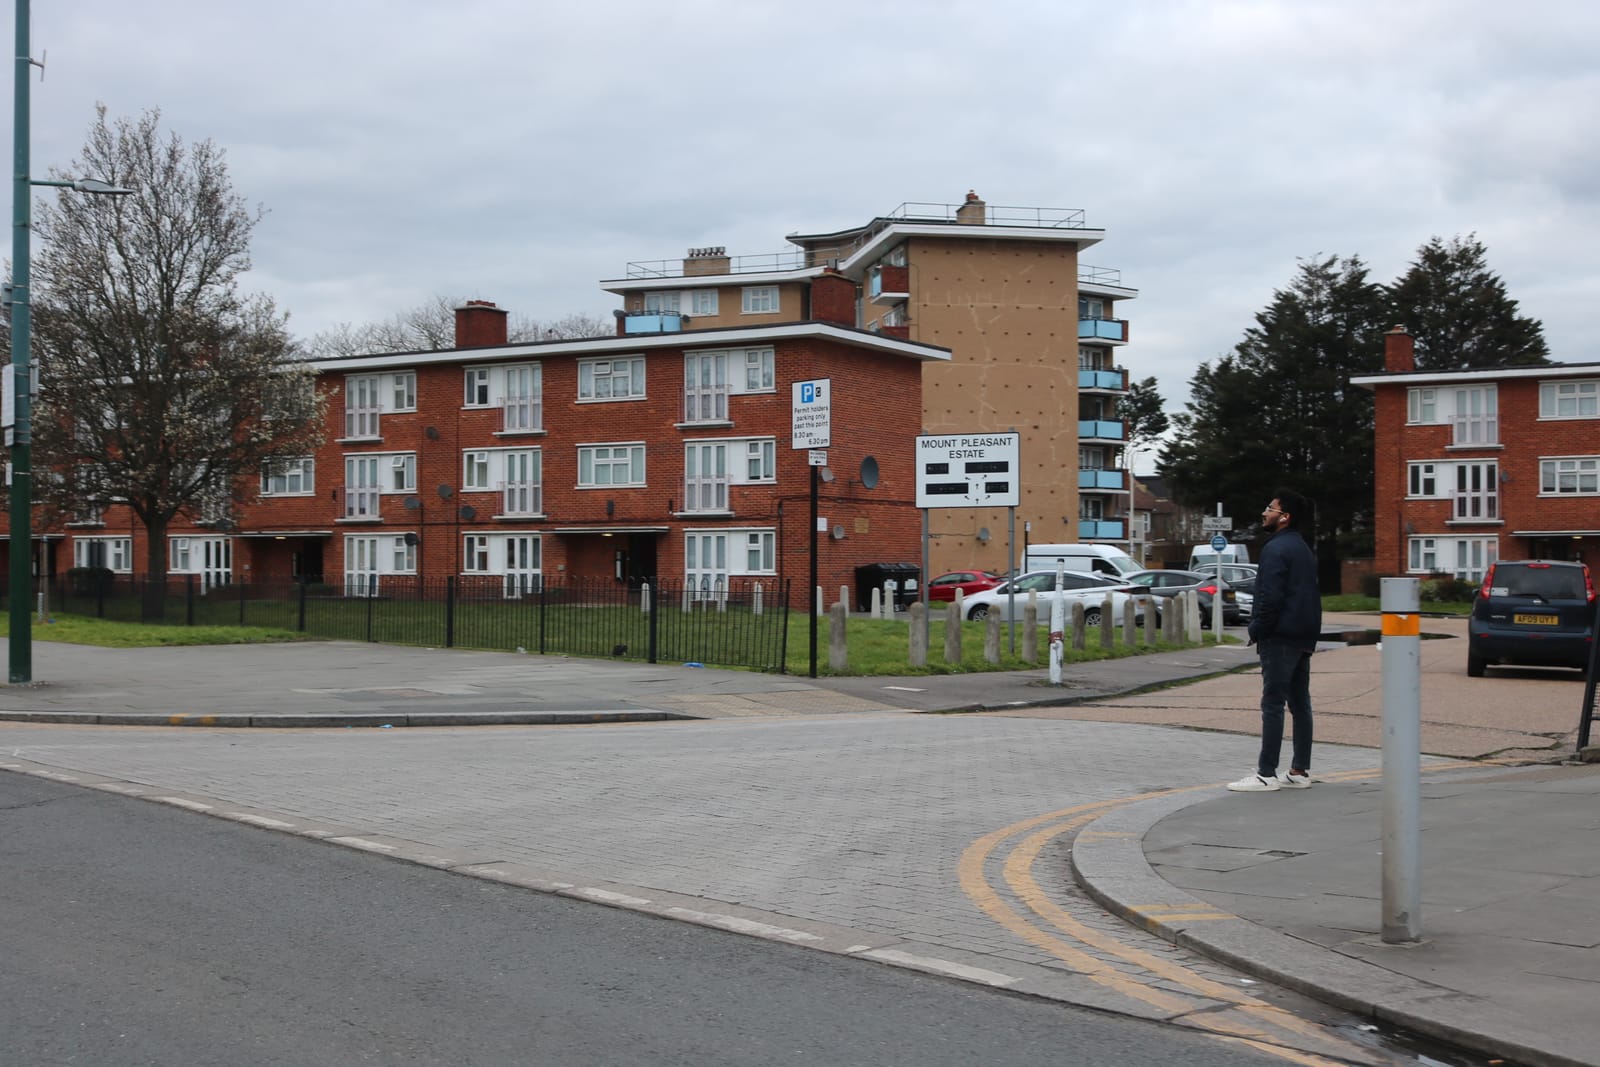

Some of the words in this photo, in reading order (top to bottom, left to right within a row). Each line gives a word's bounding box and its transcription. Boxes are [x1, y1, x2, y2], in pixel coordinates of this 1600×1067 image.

[804, 386, 812, 402] P
[922, 439, 957, 448] MOUNT
[961, 438, 1012, 447] PLEASANT
[949, 450, 984, 459] ESTATE
